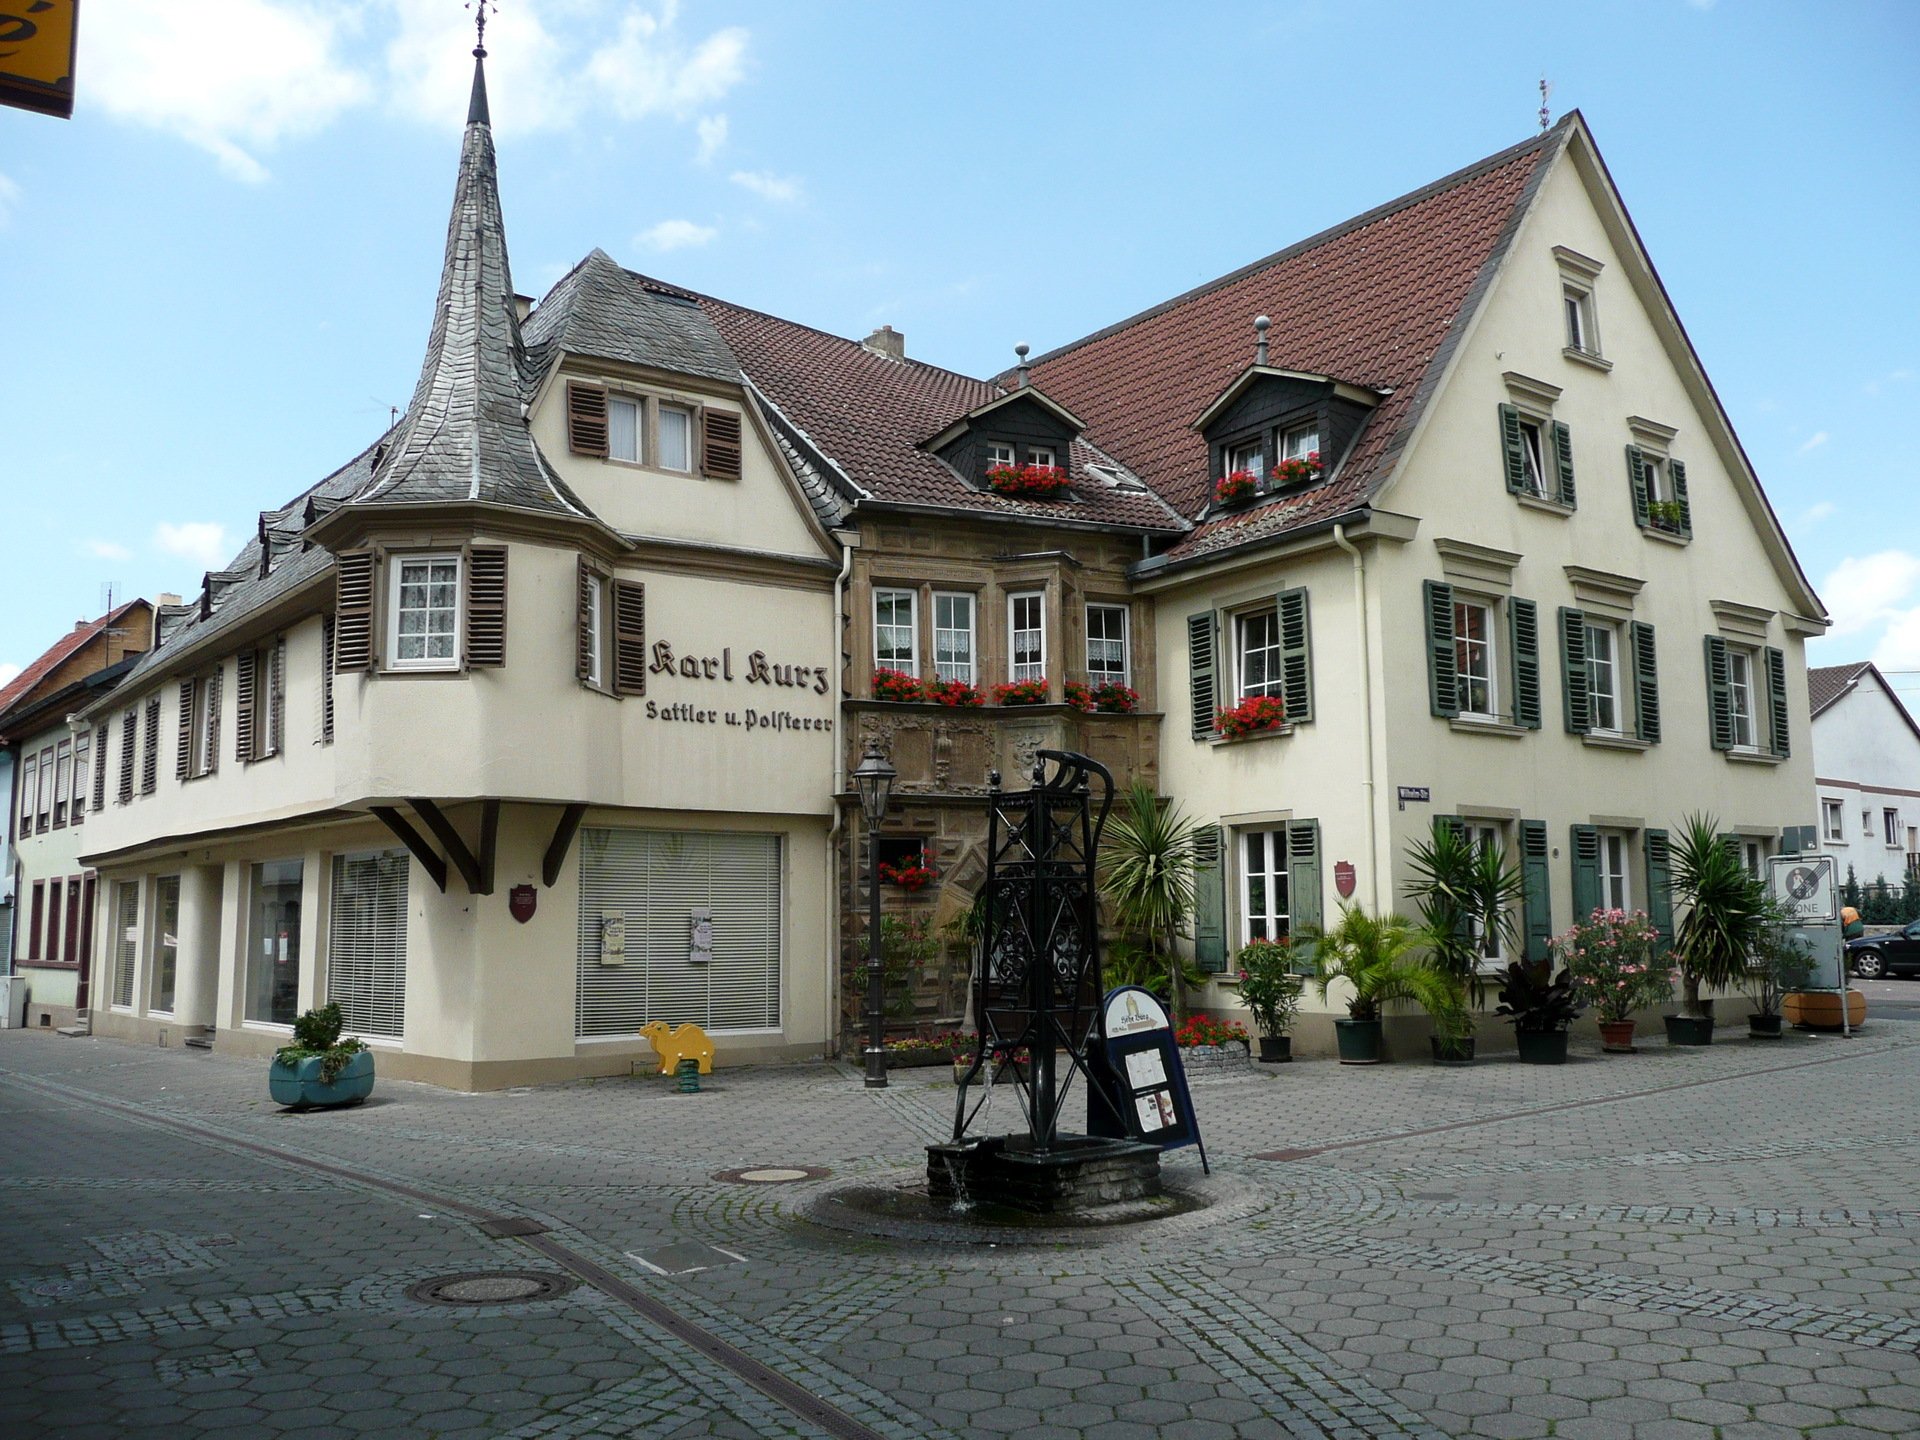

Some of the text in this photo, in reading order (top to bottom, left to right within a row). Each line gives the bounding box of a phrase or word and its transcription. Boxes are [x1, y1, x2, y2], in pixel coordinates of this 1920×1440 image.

[649, 639, 830, 696] Karl Kurz
[646, 699, 717, 724] Sattler
[725, 711, 742, 726] u.
